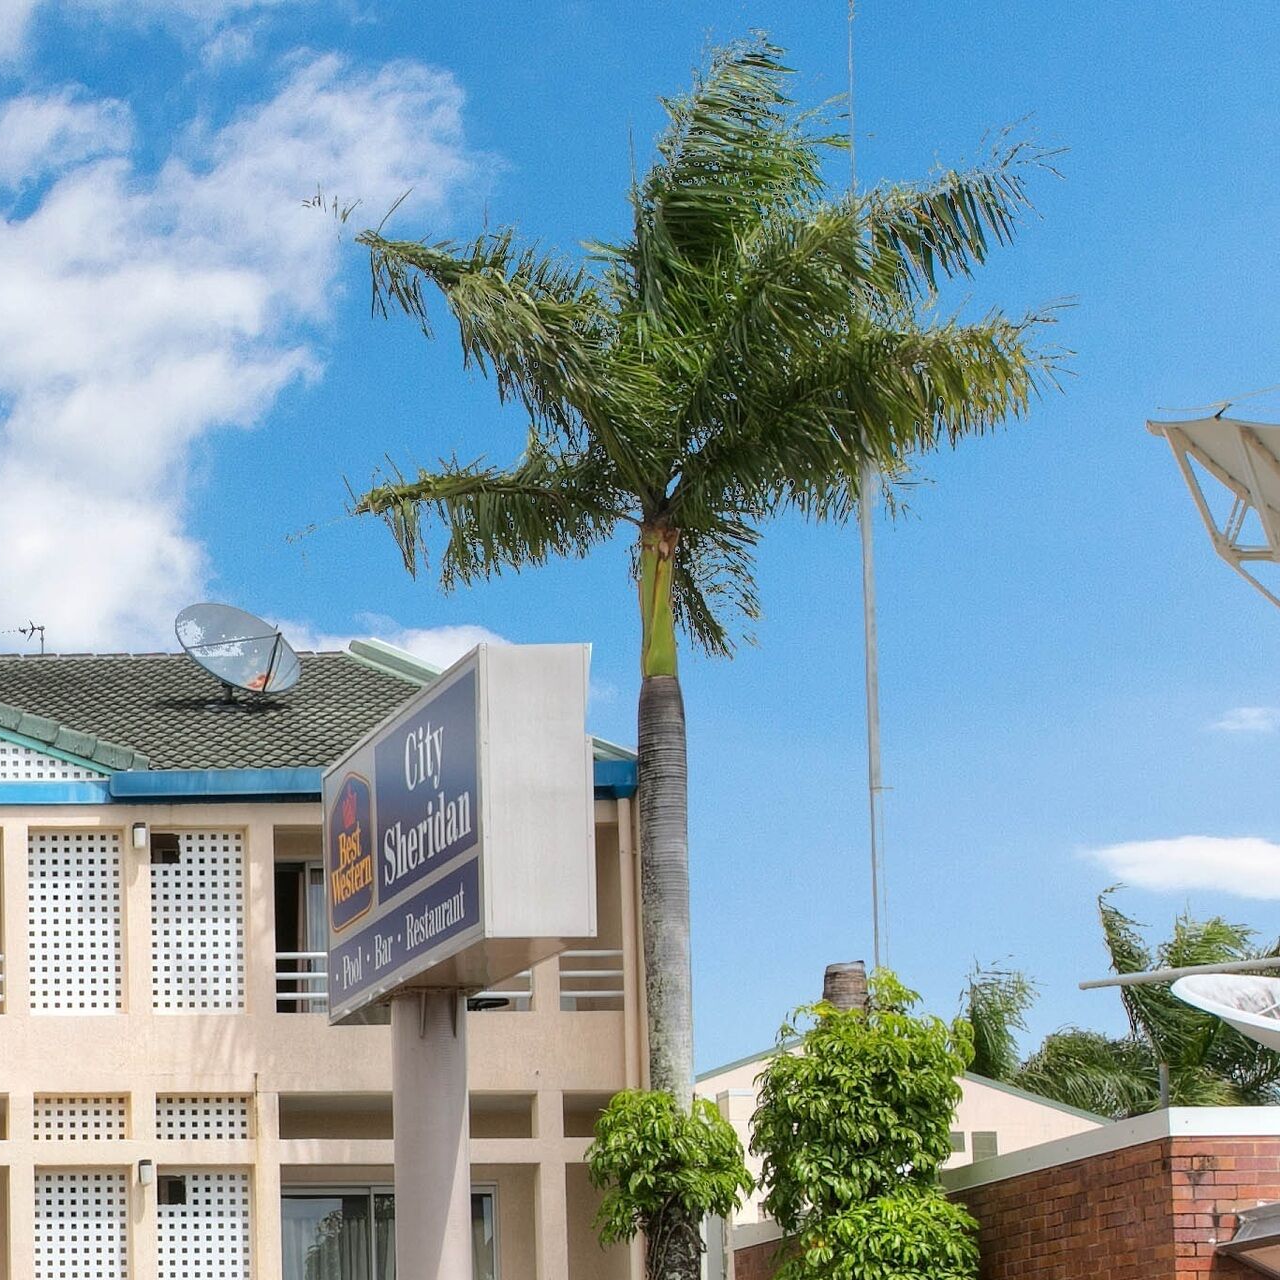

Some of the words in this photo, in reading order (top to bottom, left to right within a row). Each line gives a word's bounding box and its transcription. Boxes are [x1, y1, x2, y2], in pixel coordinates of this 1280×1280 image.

[404, 721, 444, 791] City
[338, 821, 362, 869] Best
[384, 791, 472, 886] Sheridan
[332, 854, 372, 907] Western
[342, 946, 363, 990] Pool
[374, 934, 393, 970] Bar
[405, 881, 465, 951] Restaurant
